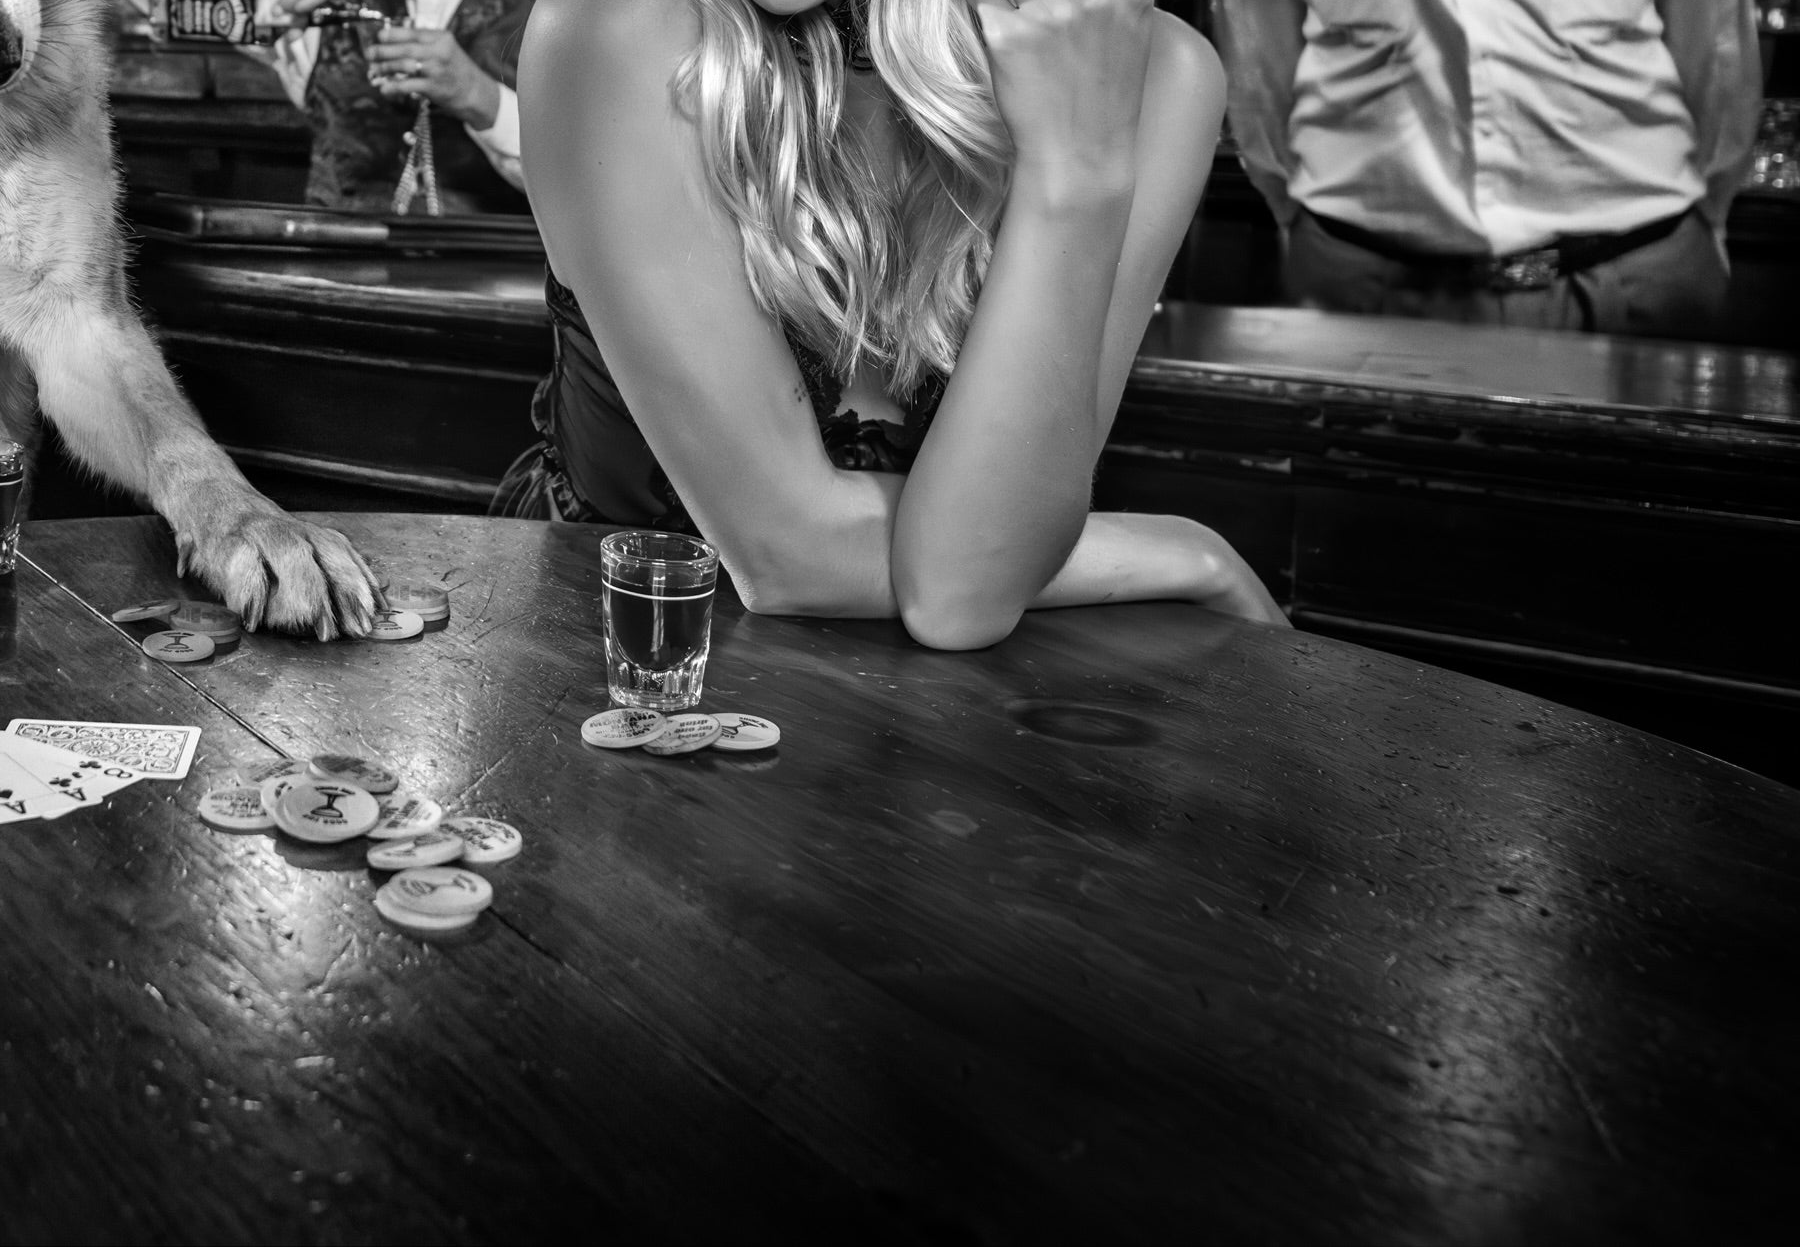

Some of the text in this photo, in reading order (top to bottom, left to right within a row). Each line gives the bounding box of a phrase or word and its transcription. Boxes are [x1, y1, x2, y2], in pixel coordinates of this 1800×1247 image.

[103, 767, 133, 779] 8
[59, 787, 86, 801] A
[0, 800, 26, 814] A
